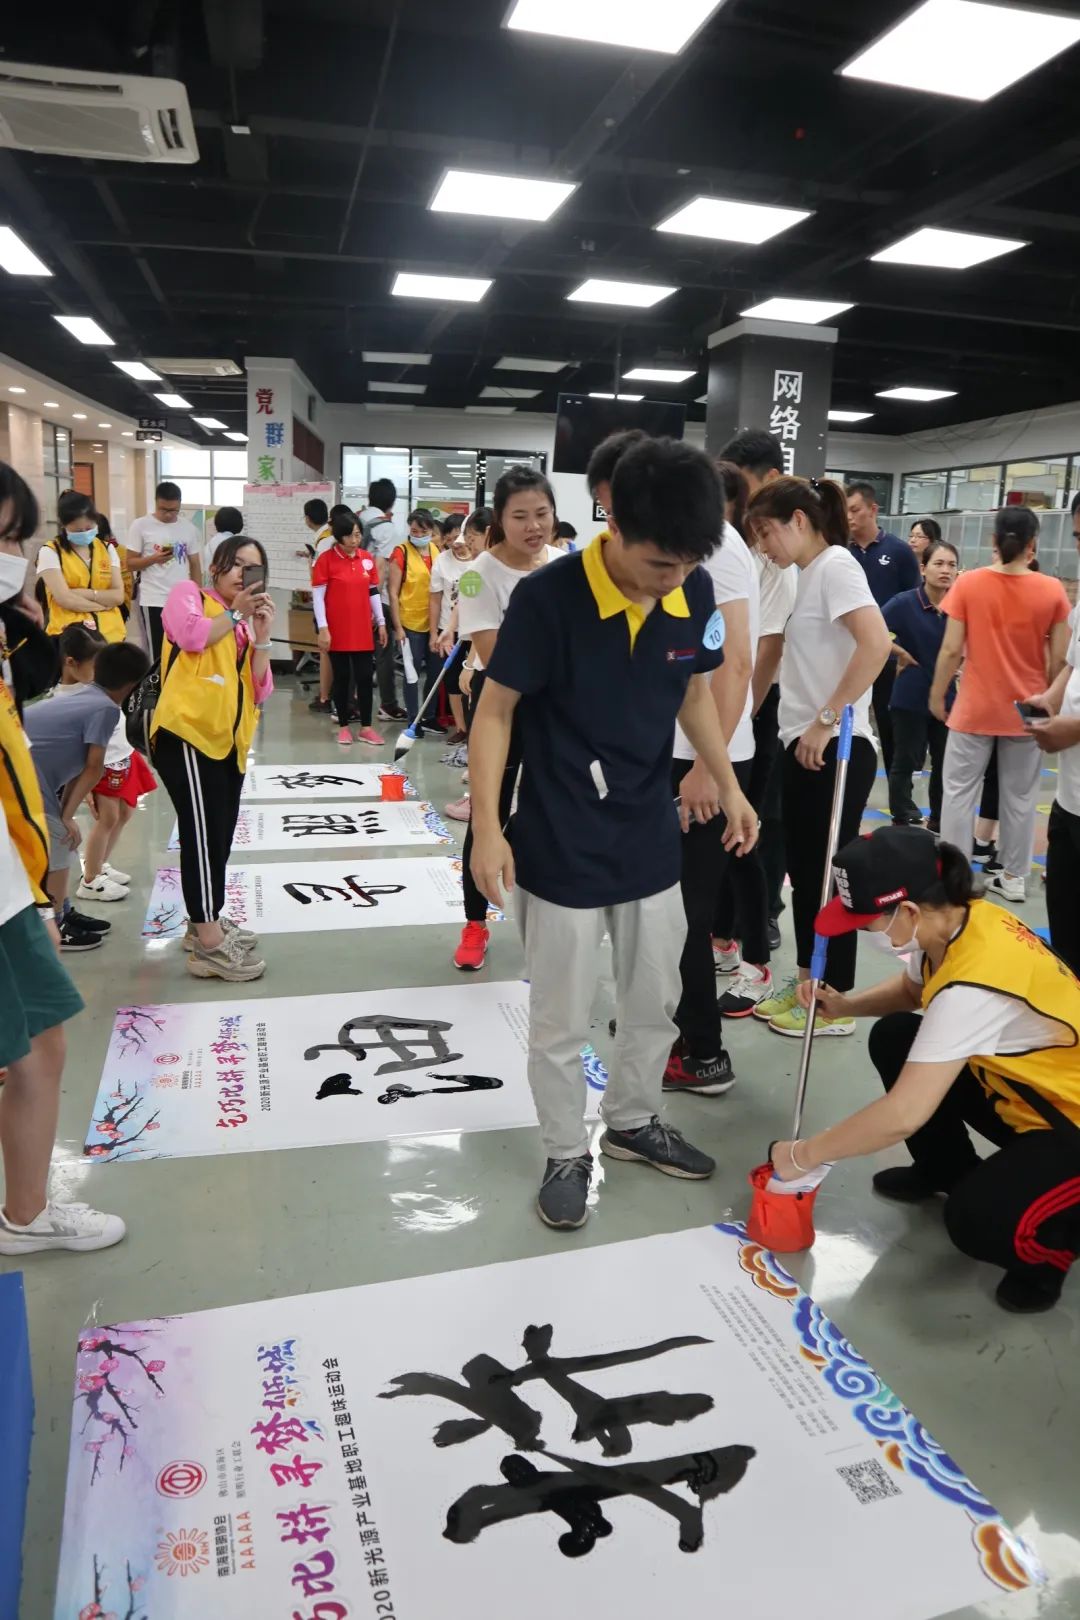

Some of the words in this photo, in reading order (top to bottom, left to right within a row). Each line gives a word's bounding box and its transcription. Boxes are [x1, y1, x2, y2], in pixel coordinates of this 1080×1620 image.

[709, 629, 722, 646] 10
[281, 810, 388, 838] 照
[283, 874, 407, 908] 寻
[303, 1015, 504, 1105] 油
[376, 1323, 757, 1558] 拼
